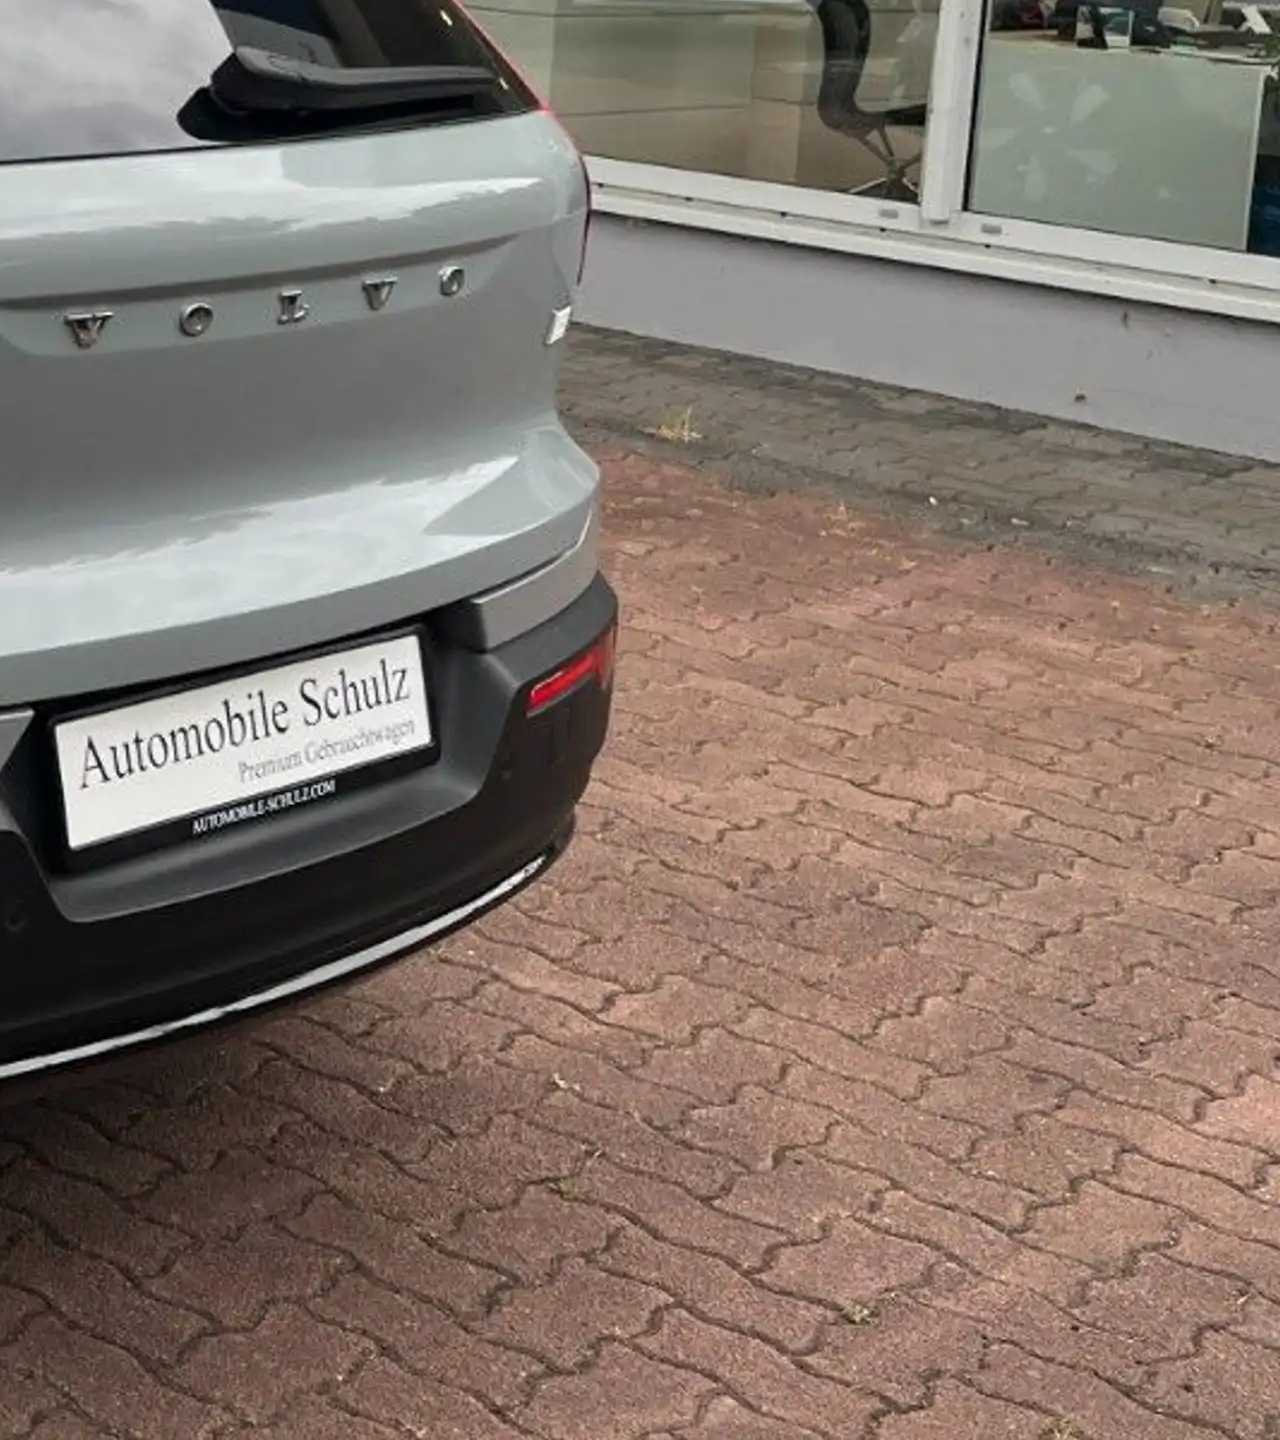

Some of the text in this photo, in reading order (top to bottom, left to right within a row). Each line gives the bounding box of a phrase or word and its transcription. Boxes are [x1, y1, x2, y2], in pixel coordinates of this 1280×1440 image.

[63, 265, 467, 349] VOLVO
[78, 658, 412, 790] Automobile Schulz
[237, 750, 304, 783] Premium
